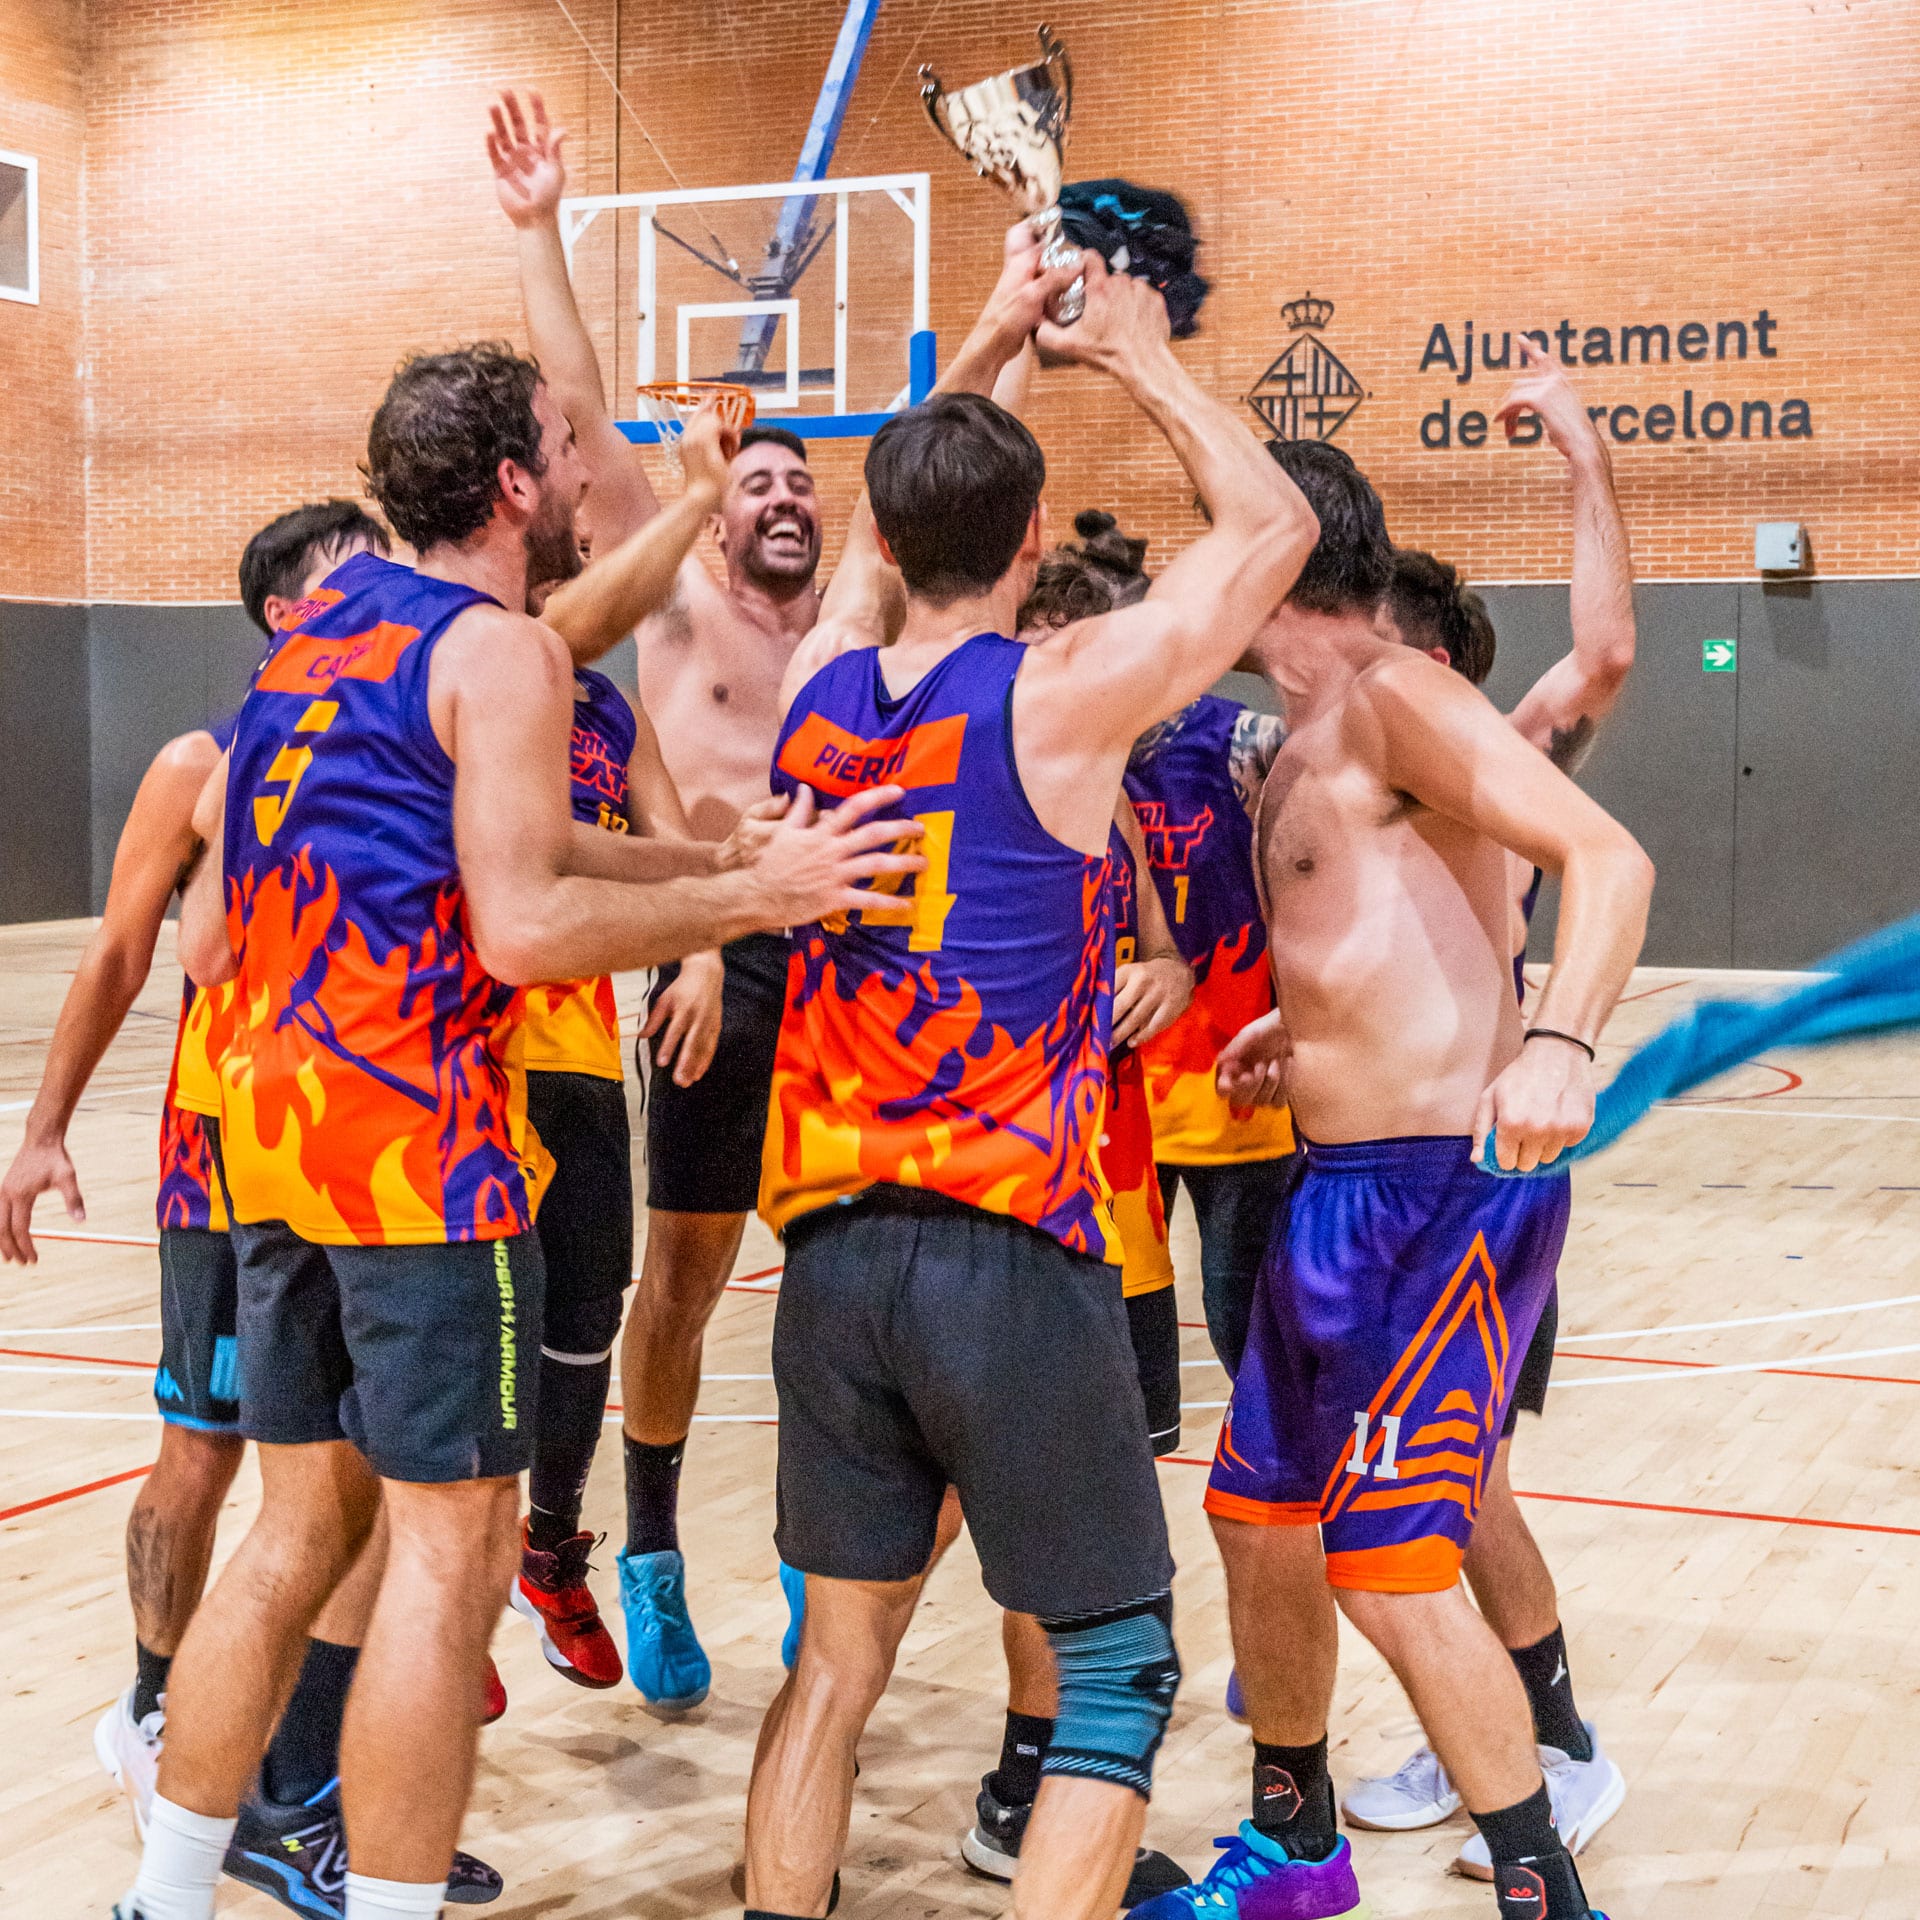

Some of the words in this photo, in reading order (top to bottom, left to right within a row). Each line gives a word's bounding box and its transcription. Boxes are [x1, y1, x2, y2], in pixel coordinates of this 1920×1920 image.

[1419, 309, 1778, 384] Ajuntament
[1420, 399, 1488, 448] de
[500, 1325, 518, 1430] ARMOUR
[1346, 1411, 1401, 1479] 11
